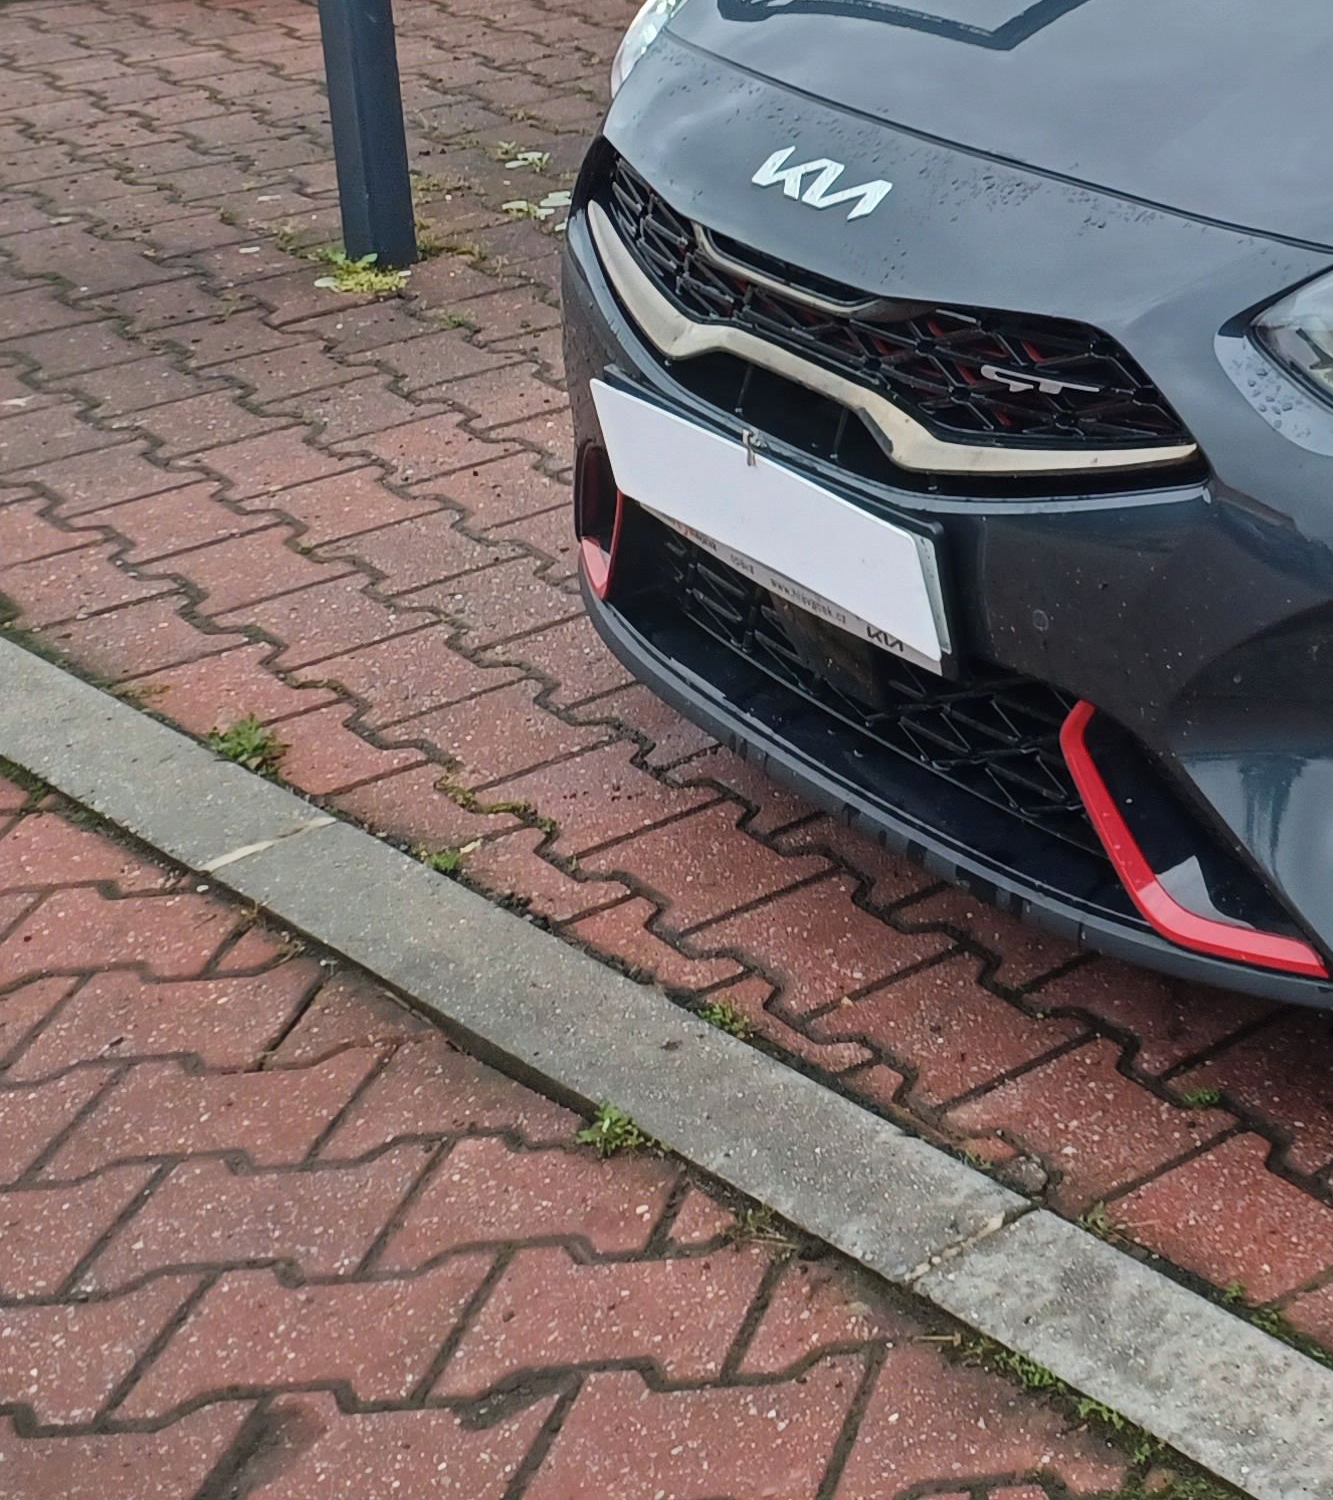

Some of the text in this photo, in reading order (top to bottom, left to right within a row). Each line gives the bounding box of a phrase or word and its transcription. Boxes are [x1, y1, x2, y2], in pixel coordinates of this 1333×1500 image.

[751, 145, 893, 221] KIA
[980, 364, 1100, 395] GT
[866, 625, 904, 653] KIA
